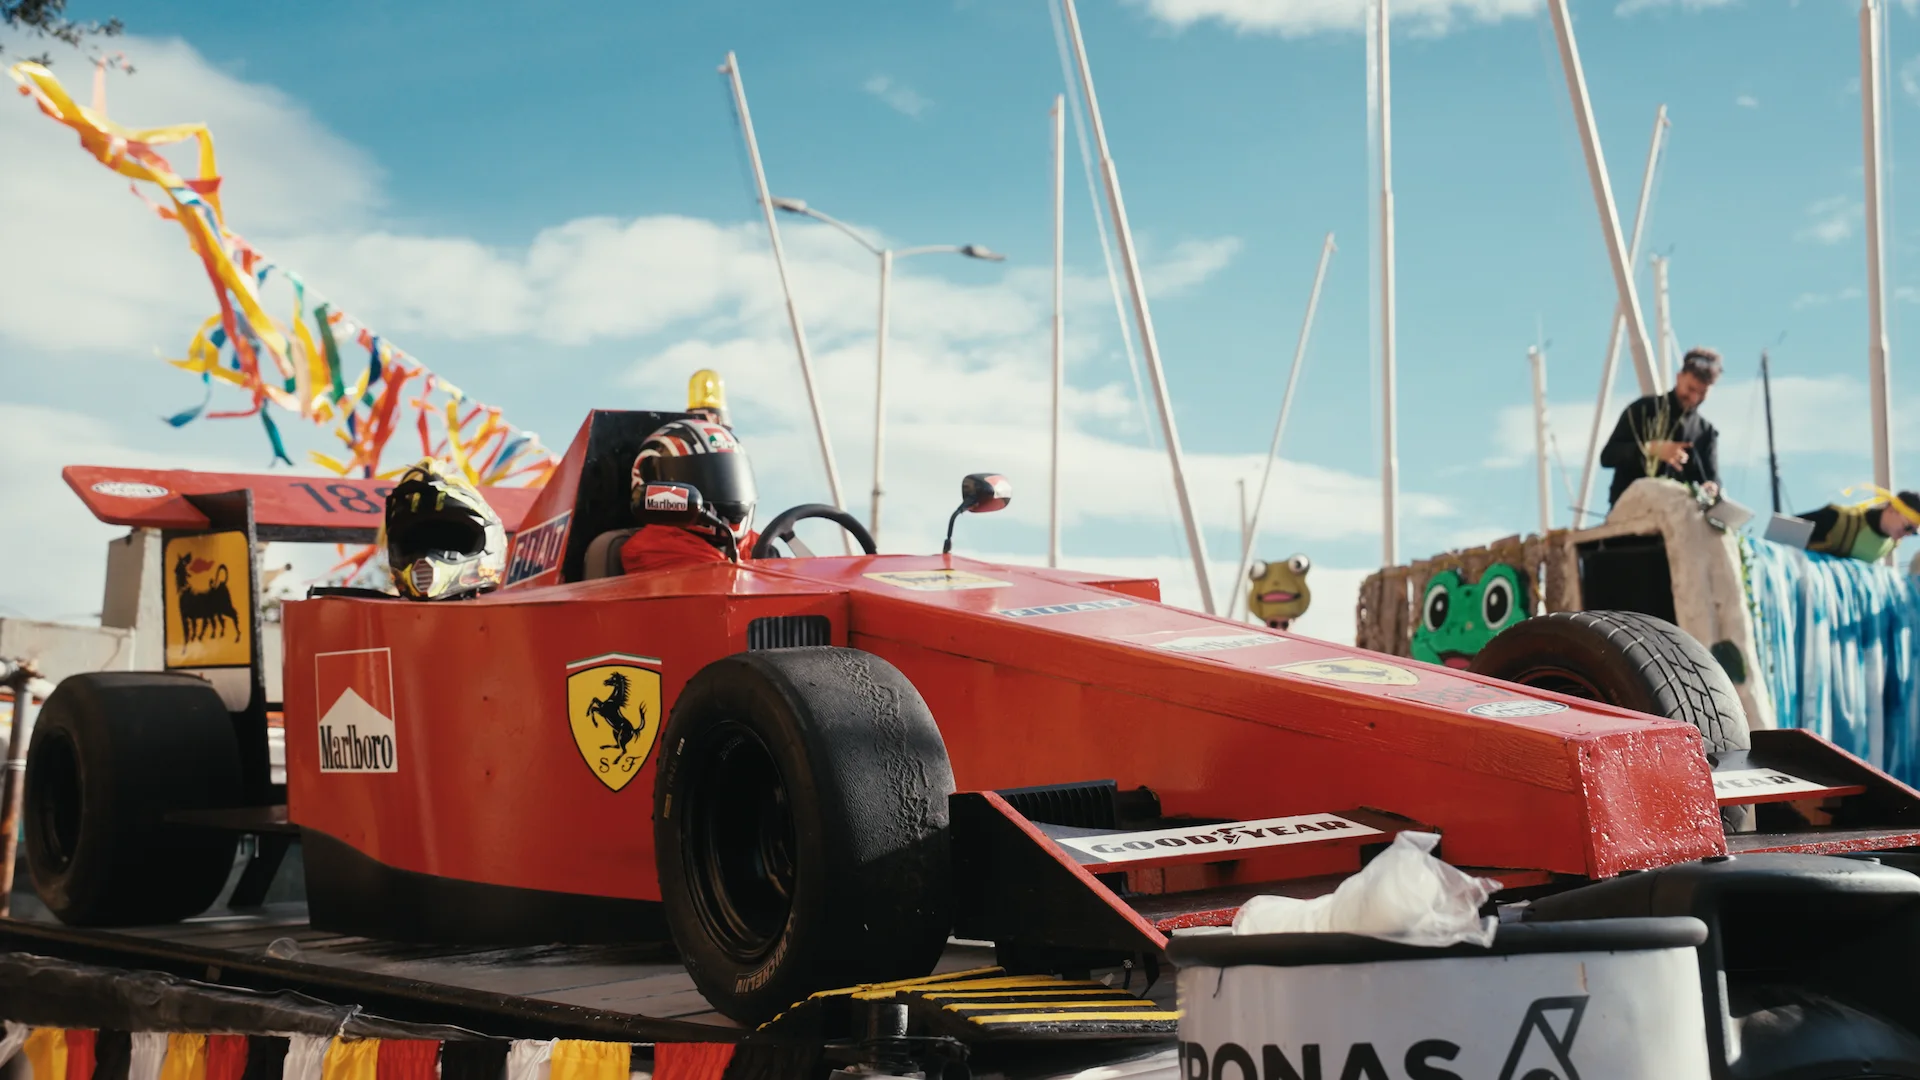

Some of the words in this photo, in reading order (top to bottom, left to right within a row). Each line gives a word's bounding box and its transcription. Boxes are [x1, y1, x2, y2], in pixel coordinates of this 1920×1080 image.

[647, 498, 686, 510] Marlboro
[509, 523, 565, 577] FIAT
[320, 724, 393, 770] Marlboro
[599, 757, 610, 773] S
[621, 756, 642, 772] F
[735, 934, 788, 993] MICHELIN
